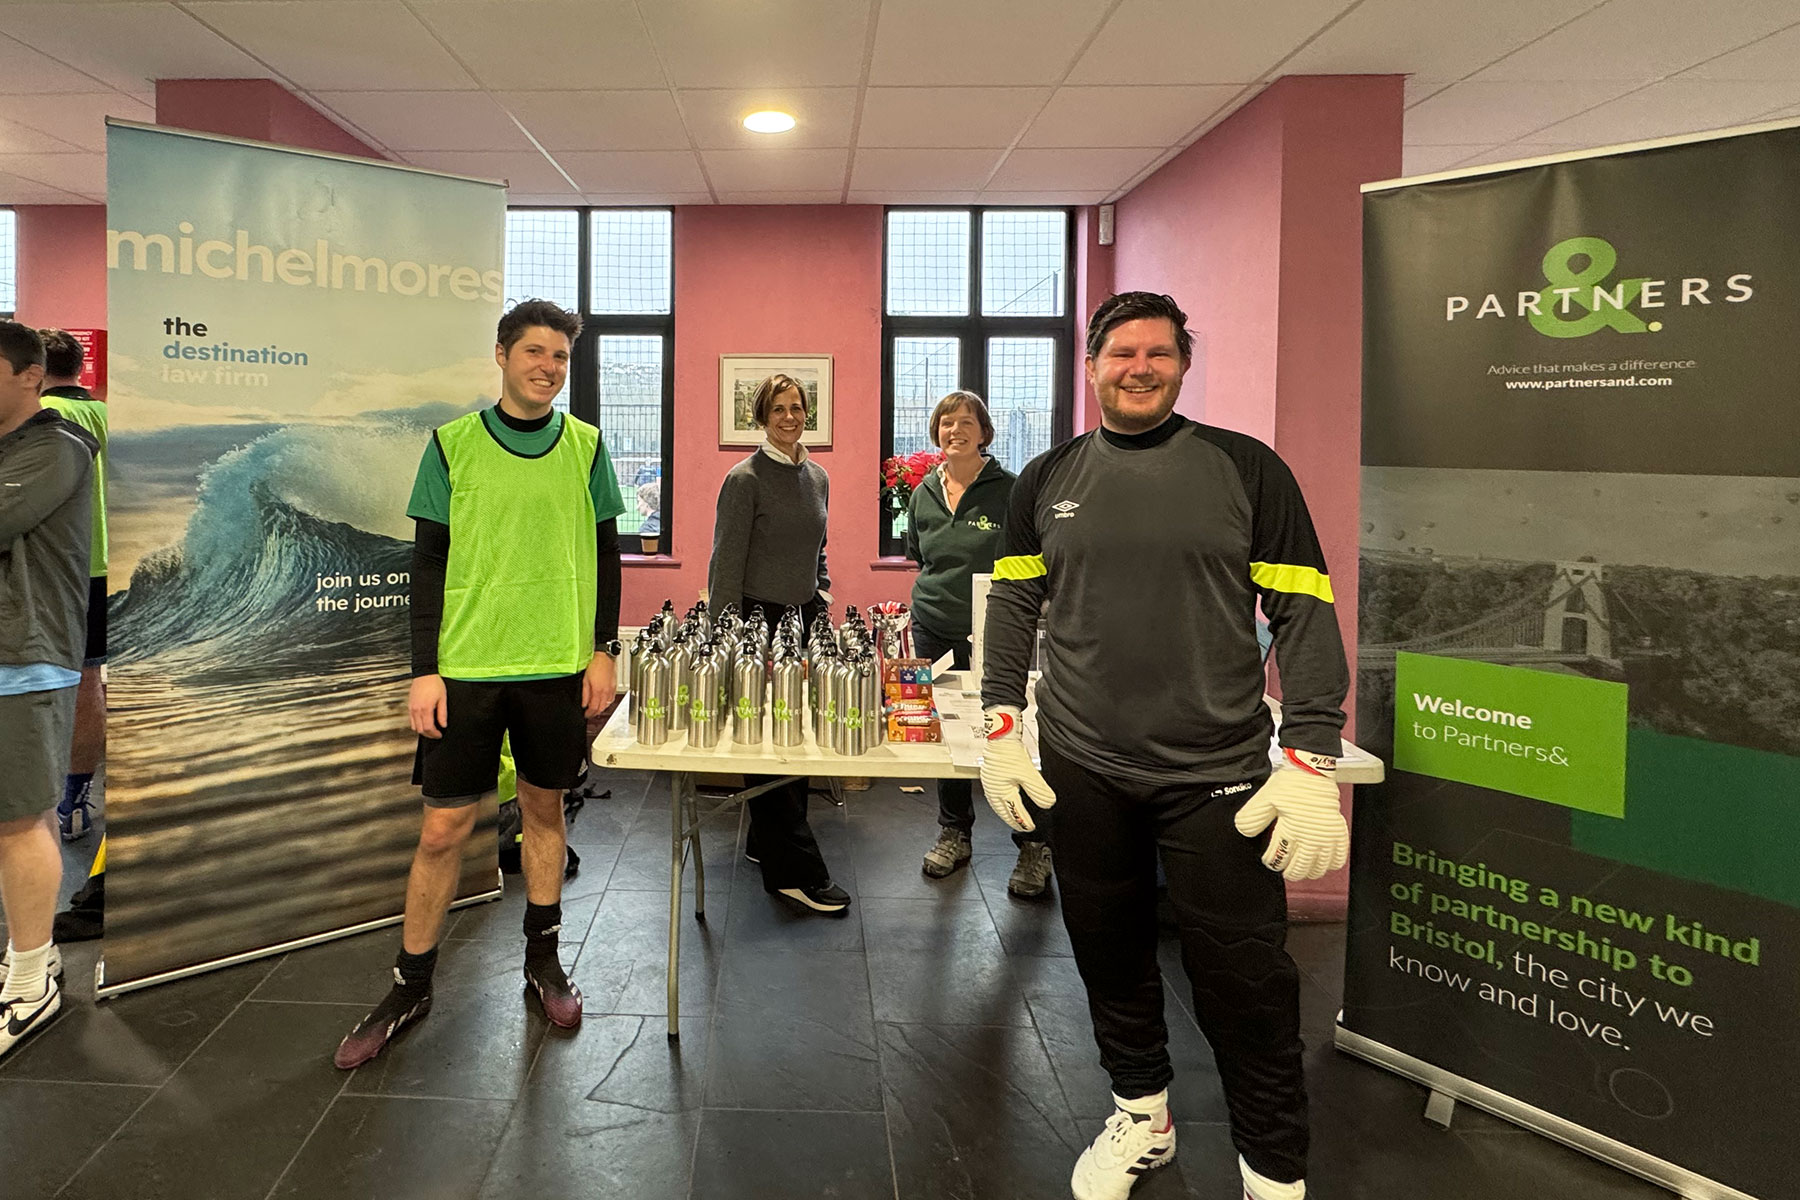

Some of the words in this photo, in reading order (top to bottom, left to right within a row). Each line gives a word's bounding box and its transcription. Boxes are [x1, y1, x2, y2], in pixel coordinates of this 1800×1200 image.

[106, 221, 503, 303] michelmores
[1446, 273, 1754, 321] PARTNERS
[163, 316, 208, 337] the
[163, 340, 309, 366] destination
[1487, 364, 1531, 376] Advice
[1533, 363, 1560, 375] that
[1562, 361, 1606, 374] makes
[1608, 363, 1617, 372] a
[1619, 359, 1697, 371] difference
[161, 364, 208, 384] law
[212, 365, 269, 387] firm
[1505, 376, 1673, 391] www.partnersand.com
[315, 571, 352, 593] join
[359, 573, 381, 587] us
[386, 571, 411, 585] on
[316, 596, 349, 612] the
[1413, 692, 1533, 730] Welcome
[1412, 720, 1437, 740] to
[1443, 725, 1570, 767] Partners&
[1224, 782, 1252, 796] Sondico
[1392, 842, 1530, 904] Bringing
[1539, 884, 1560, 908] a
[1571, 892, 1654, 934] new
[1665, 914, 1760, 967] kind
[1390, 881, 1423, 905] of
[1431, 889, 1637, 973] partnership
[1647, 954, 1694, 988] to
[1390, 911, 1505, 970] Bristol,
[1513, 950, 1570, 990] the
[1578, 974, 1647, 1017] city
[1654, 999, 1714, 1038] we
[1390, 946, 1472, 993] know
[1478, 977, 1538, 1018] and
[1548, 999, 1632, 1051] love.
